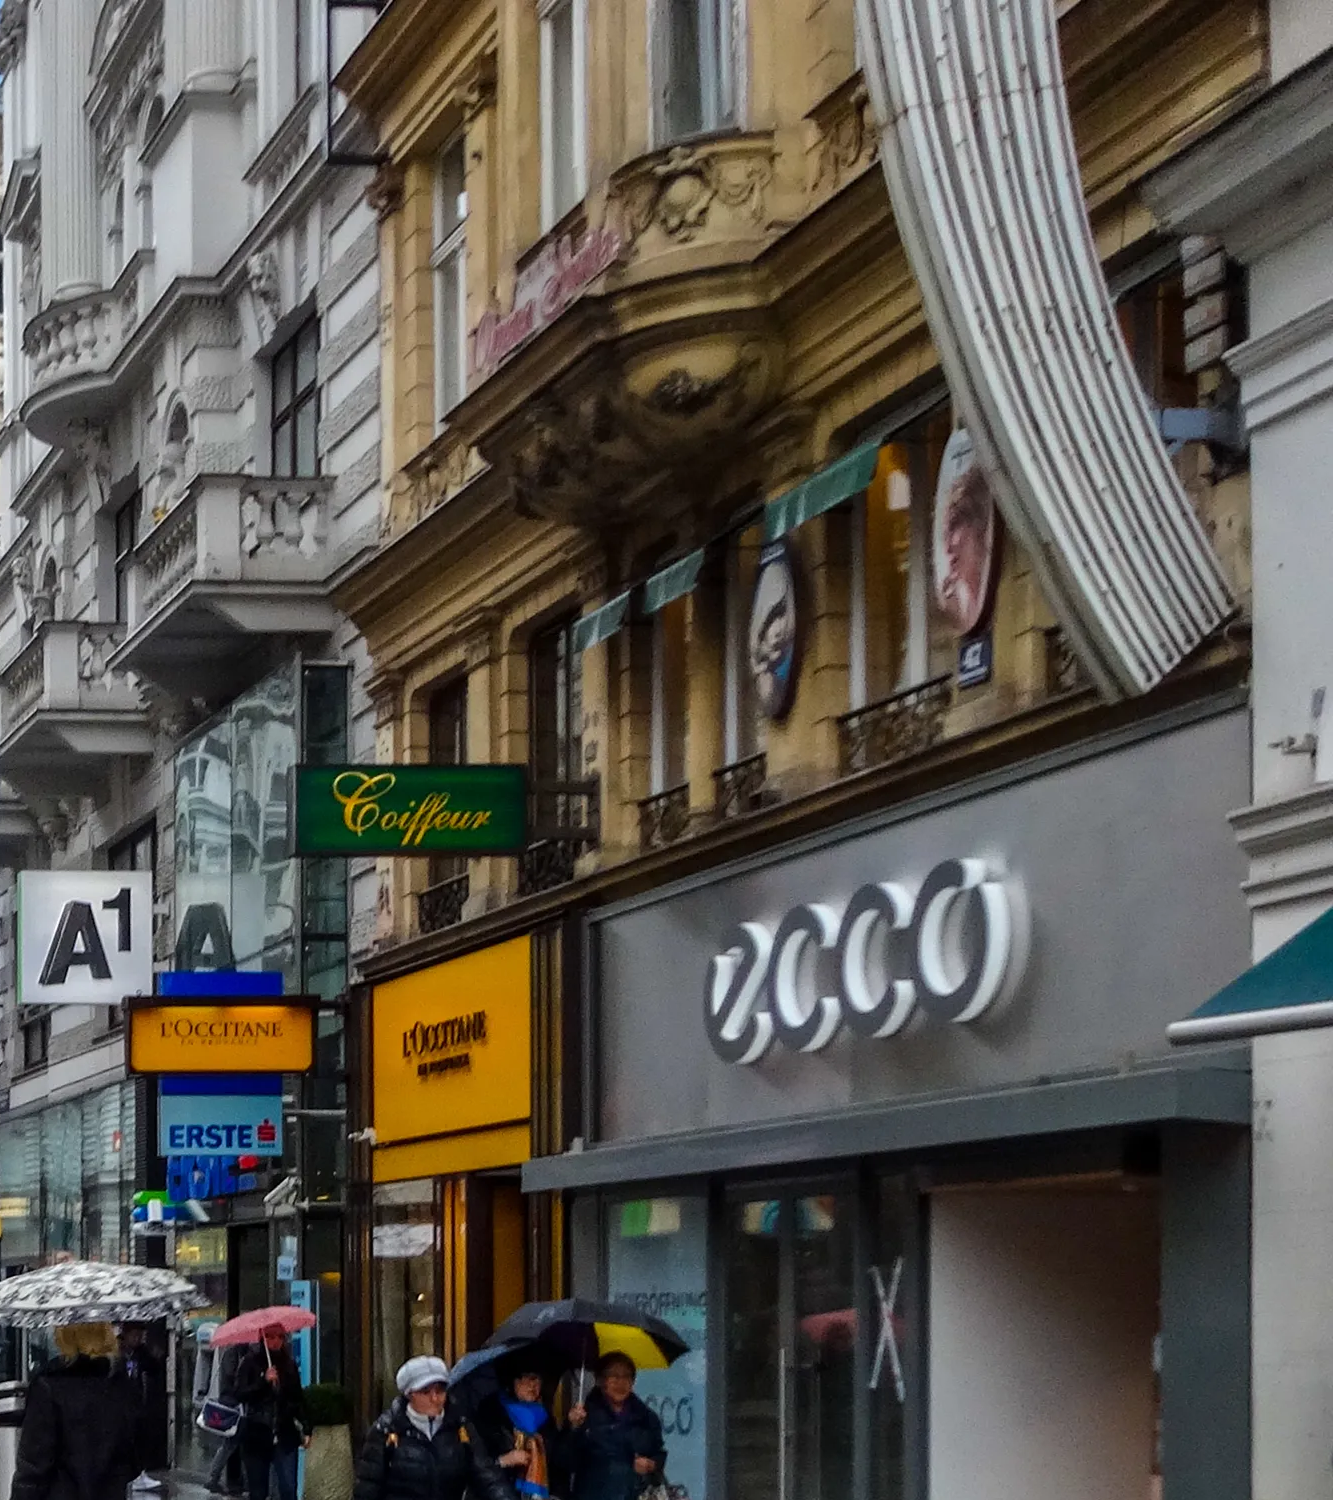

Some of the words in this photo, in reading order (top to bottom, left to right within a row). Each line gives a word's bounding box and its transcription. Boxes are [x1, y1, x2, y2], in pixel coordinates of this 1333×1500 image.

[332, 770, 492, 847] Coiffeur
[38, 886, 134, 986] A1
[704, 857, 1027, 1065] ecco
[160, 1018, 284, 1039] L'OCCITANE
[168, 1123, 253, 1149] ERSTE
